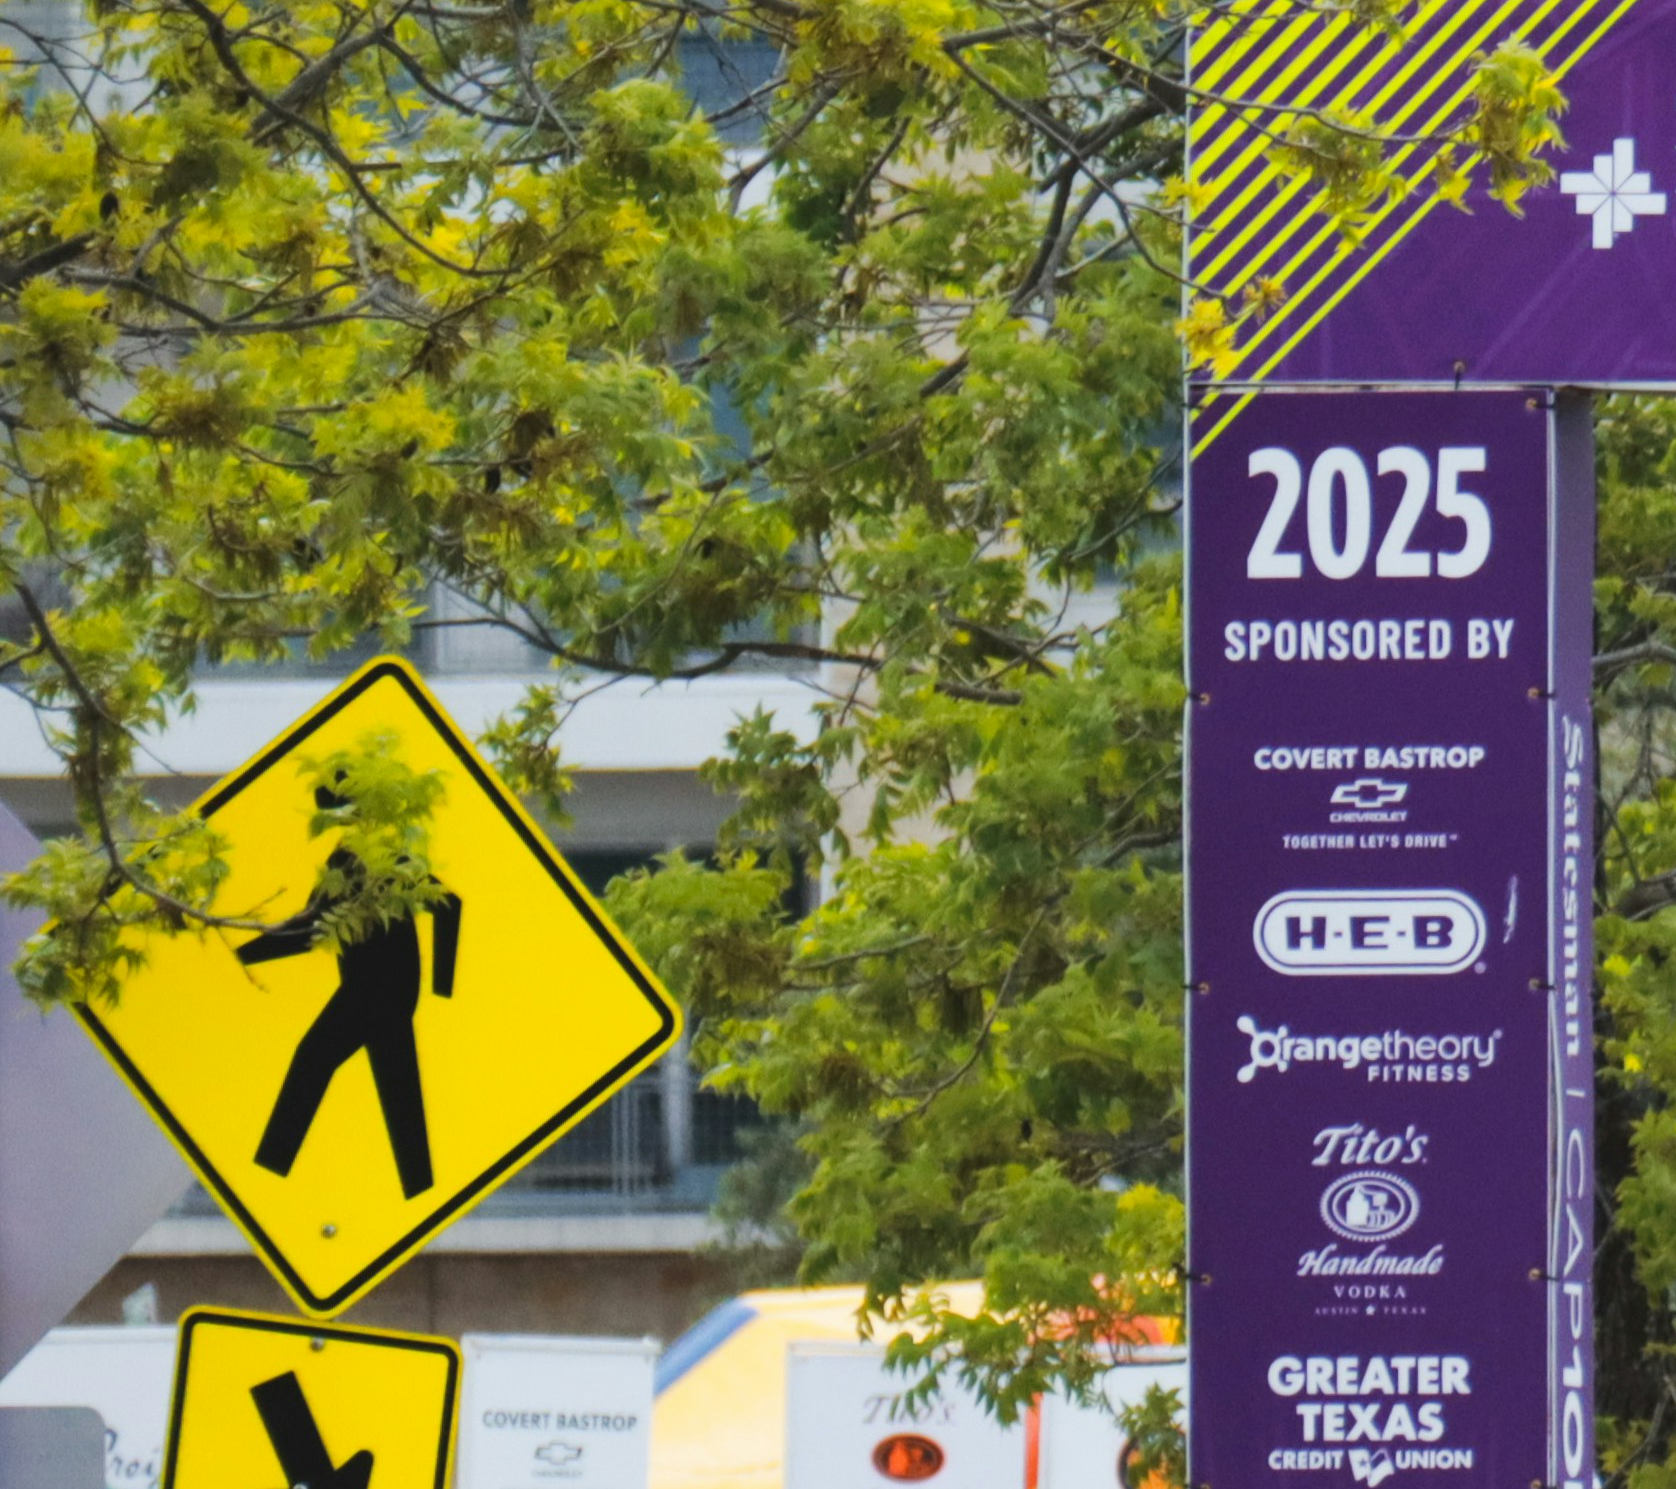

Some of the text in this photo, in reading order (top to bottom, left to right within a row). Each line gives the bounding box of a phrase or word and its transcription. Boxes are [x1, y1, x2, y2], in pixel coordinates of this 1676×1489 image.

[1247, 446, 1492, 580] 2025
[1224, 619, 1514, 662] SPONSORED BY
[1254, 746, 1486, 770] COVERT BASTROP
[1329, 811, 1408, 823] CHEVROLET
[1283, 835, 1355, 849] TOGETHER
[1360, 835, 1399, 849] LET'S
[1368, 1066, 1470, 1083] FITNESS
[1312, 1123, 1429, 1166] Tito's
[1297, 1245, 1445, 1276] Handmade
[1334, 1285, 1406, 1299] VODKA
[1267, 1356, 1471, 1396] GREATER
[482, 1411, 638, 1431] COVERT BASTROP
[1296, 1403, 1445, 1441] TEXAS
[1268, 1449, 1473, 1470] CREDIT UNION
